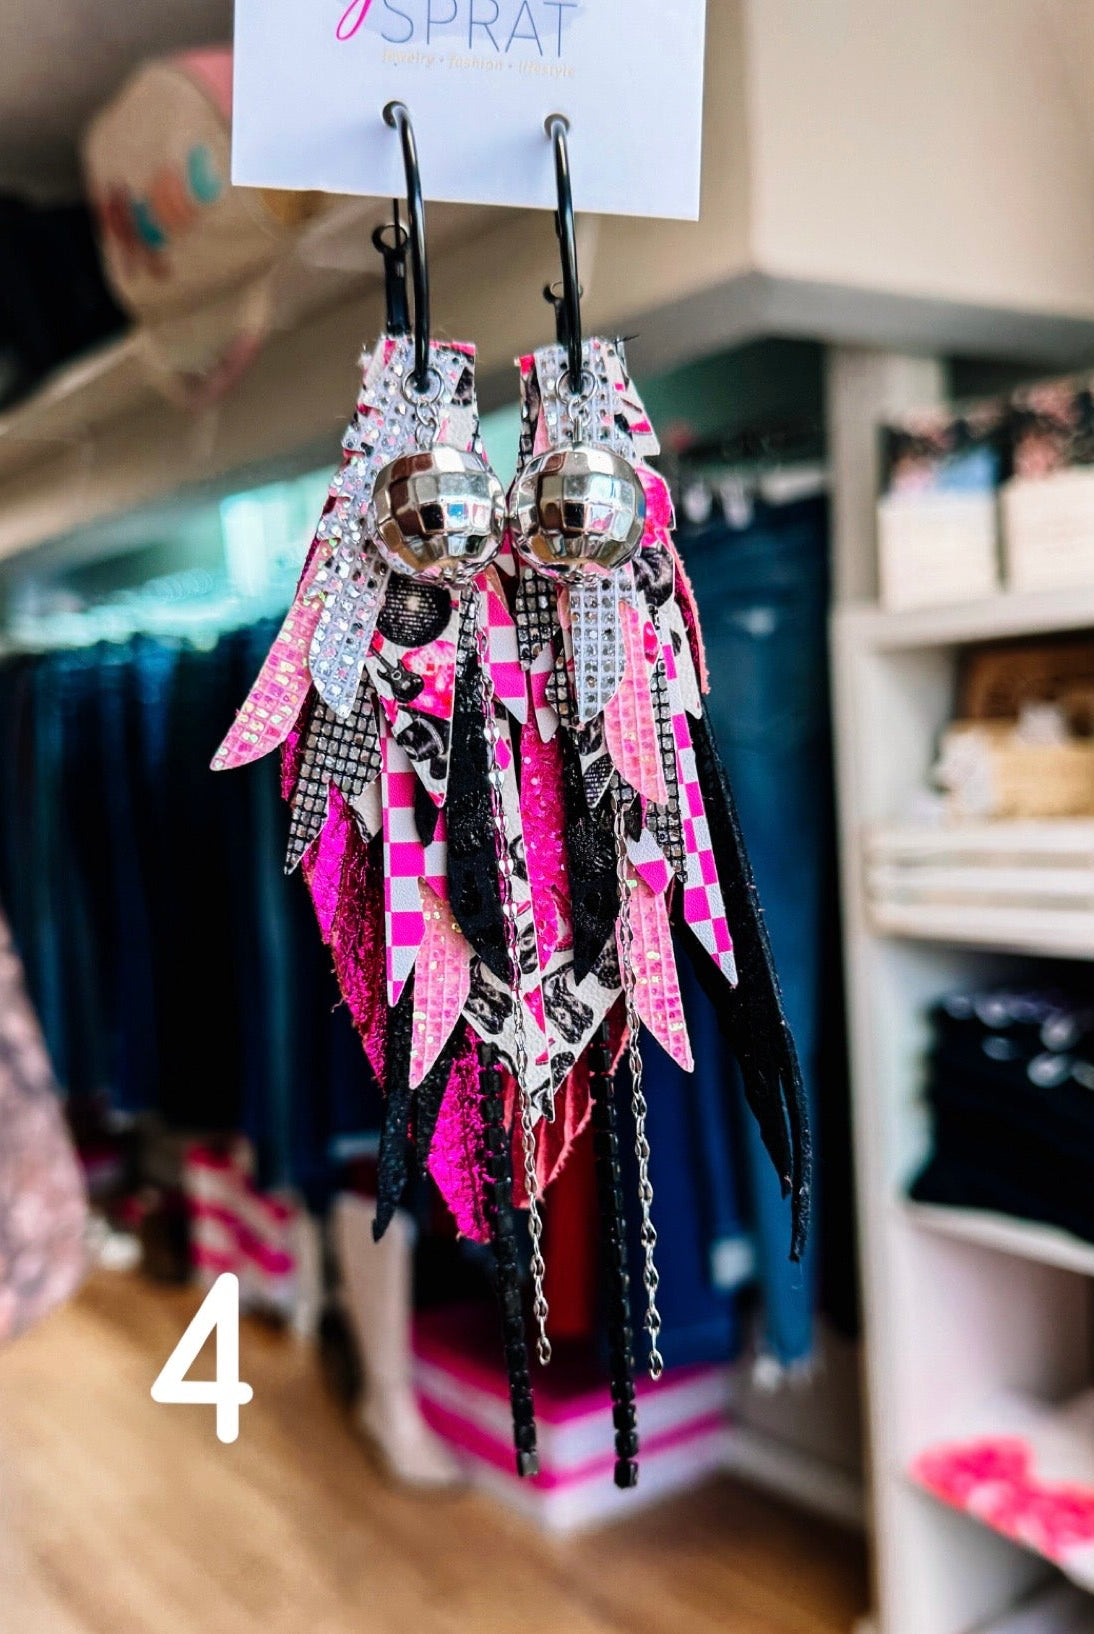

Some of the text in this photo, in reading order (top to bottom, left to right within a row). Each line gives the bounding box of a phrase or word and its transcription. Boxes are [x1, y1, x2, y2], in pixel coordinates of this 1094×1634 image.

[380, 0, 578, 58] SPRAT
[447, 54, 503, 71] fashion
[517, 60, 576, 78] lifestyle
